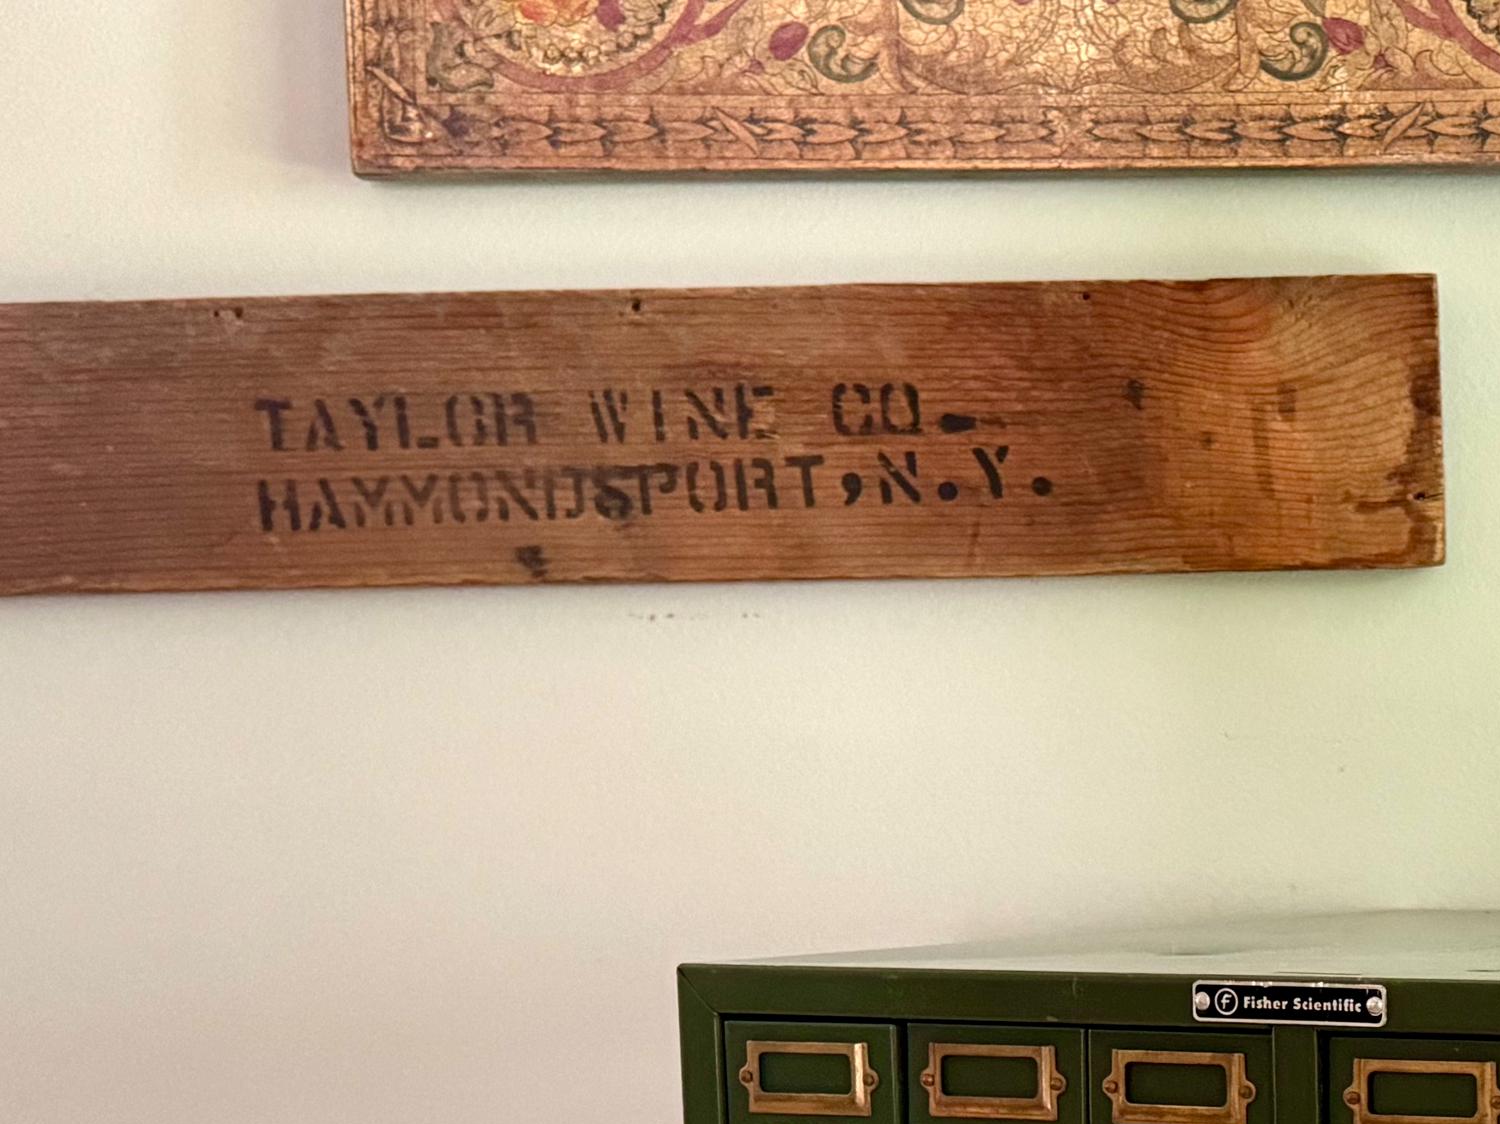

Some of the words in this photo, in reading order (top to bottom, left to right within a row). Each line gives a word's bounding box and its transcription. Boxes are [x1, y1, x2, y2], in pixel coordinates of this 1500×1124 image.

[255, 391, 538, 451] TAYLOR
[590, 382, 780, 444] WINE
[1243, 995, 1288, 1010] Fisher
[1293, 997, 1362, 1013] Scientific
